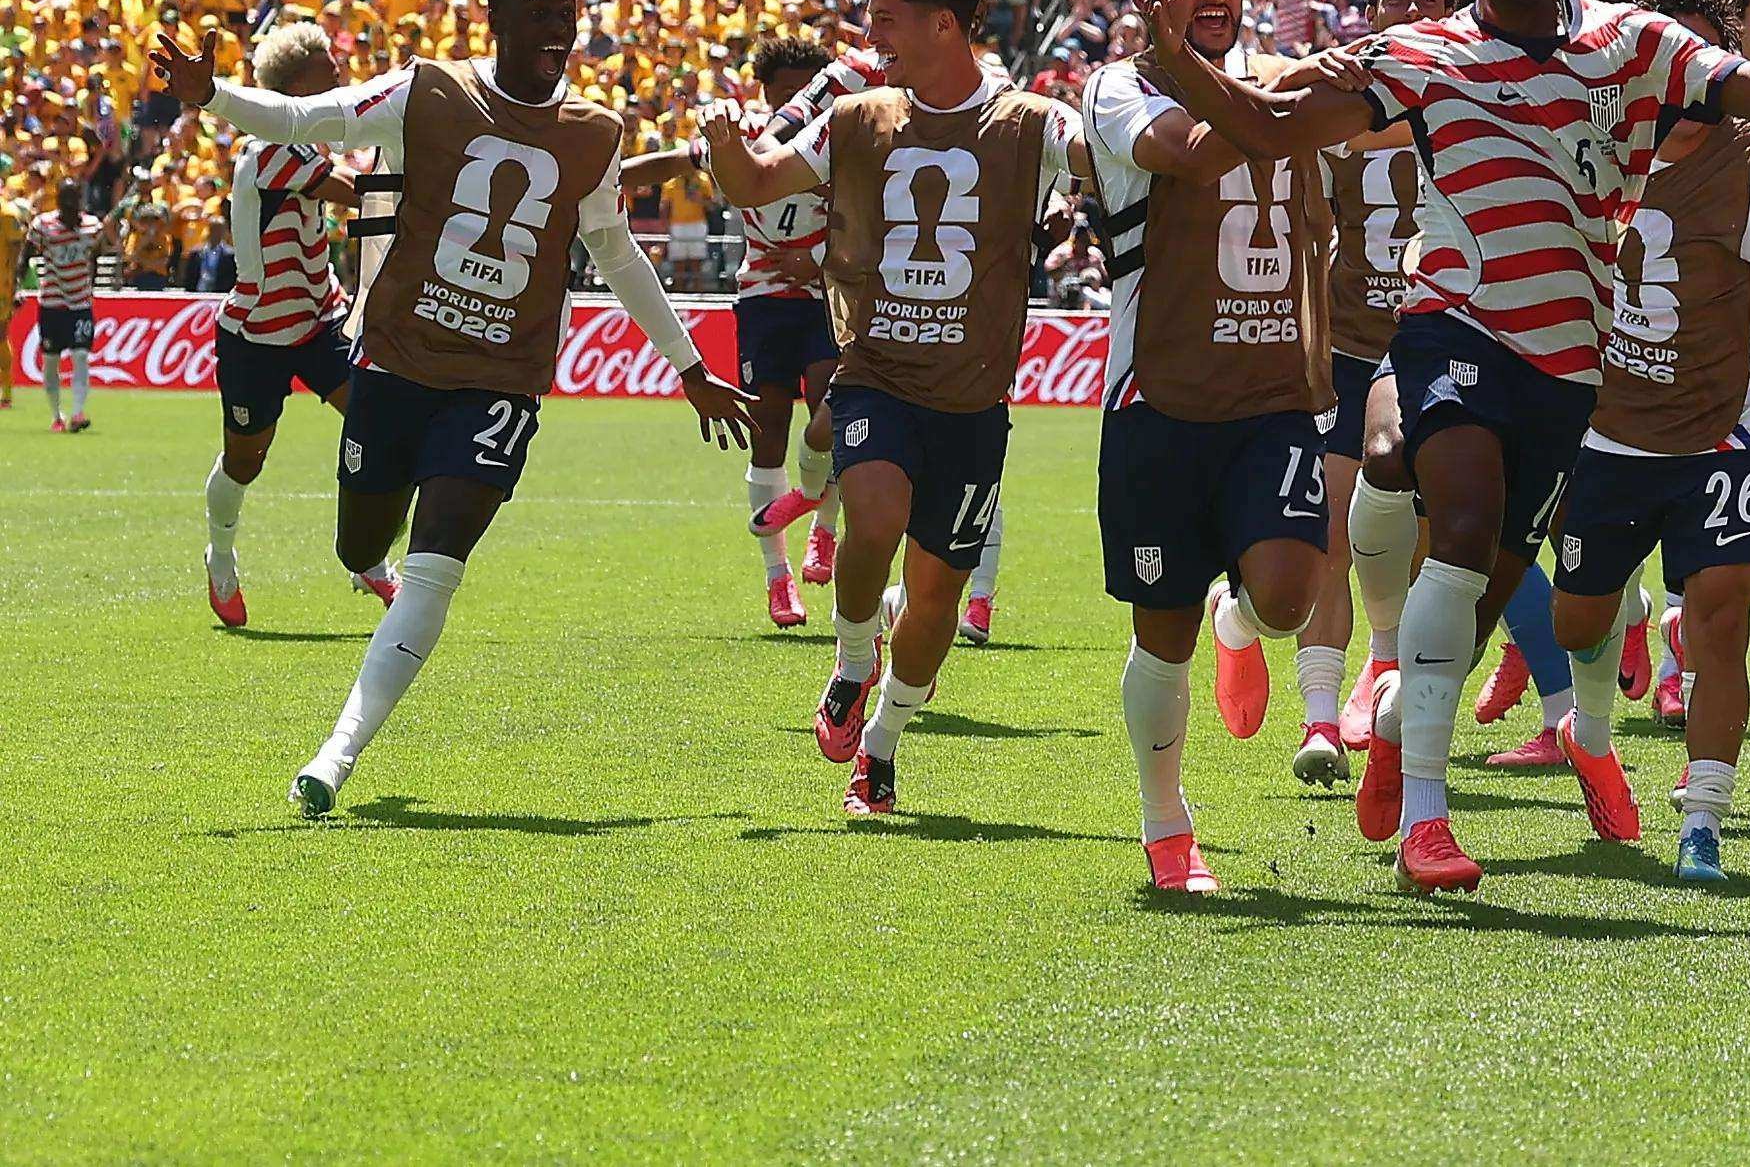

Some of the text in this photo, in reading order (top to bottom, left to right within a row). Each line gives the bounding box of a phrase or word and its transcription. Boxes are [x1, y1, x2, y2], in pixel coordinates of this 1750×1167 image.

[777, 203, 798, 237] 4
[459, 258, 503, 285] FIFA
[904, 268, 946, 286] FIFA
[1246, 257, 1280, 276] FIFA
[1365, 276, 1406, 288] WOR
[422, 280, 517, 321] WORLD CUP
[875, 299, 968, 320] WORLD CUP
[1216, 298, 1293, 316] WORLD CUP
[1366, 289, 1404, 308] 20
[413, 297, 512, 344] 2026
[868, 316, 965, 344] 2026
[1213, 317, 1299, 344] 2026
[1608, 332, 1679, 363] ORLD CUP
[1605, 345, 1675, 384] 026
[472, 399, 530, 456] 21
[1278, 445, 1324, 505] 15
[952, 482, 999, 535] 14
